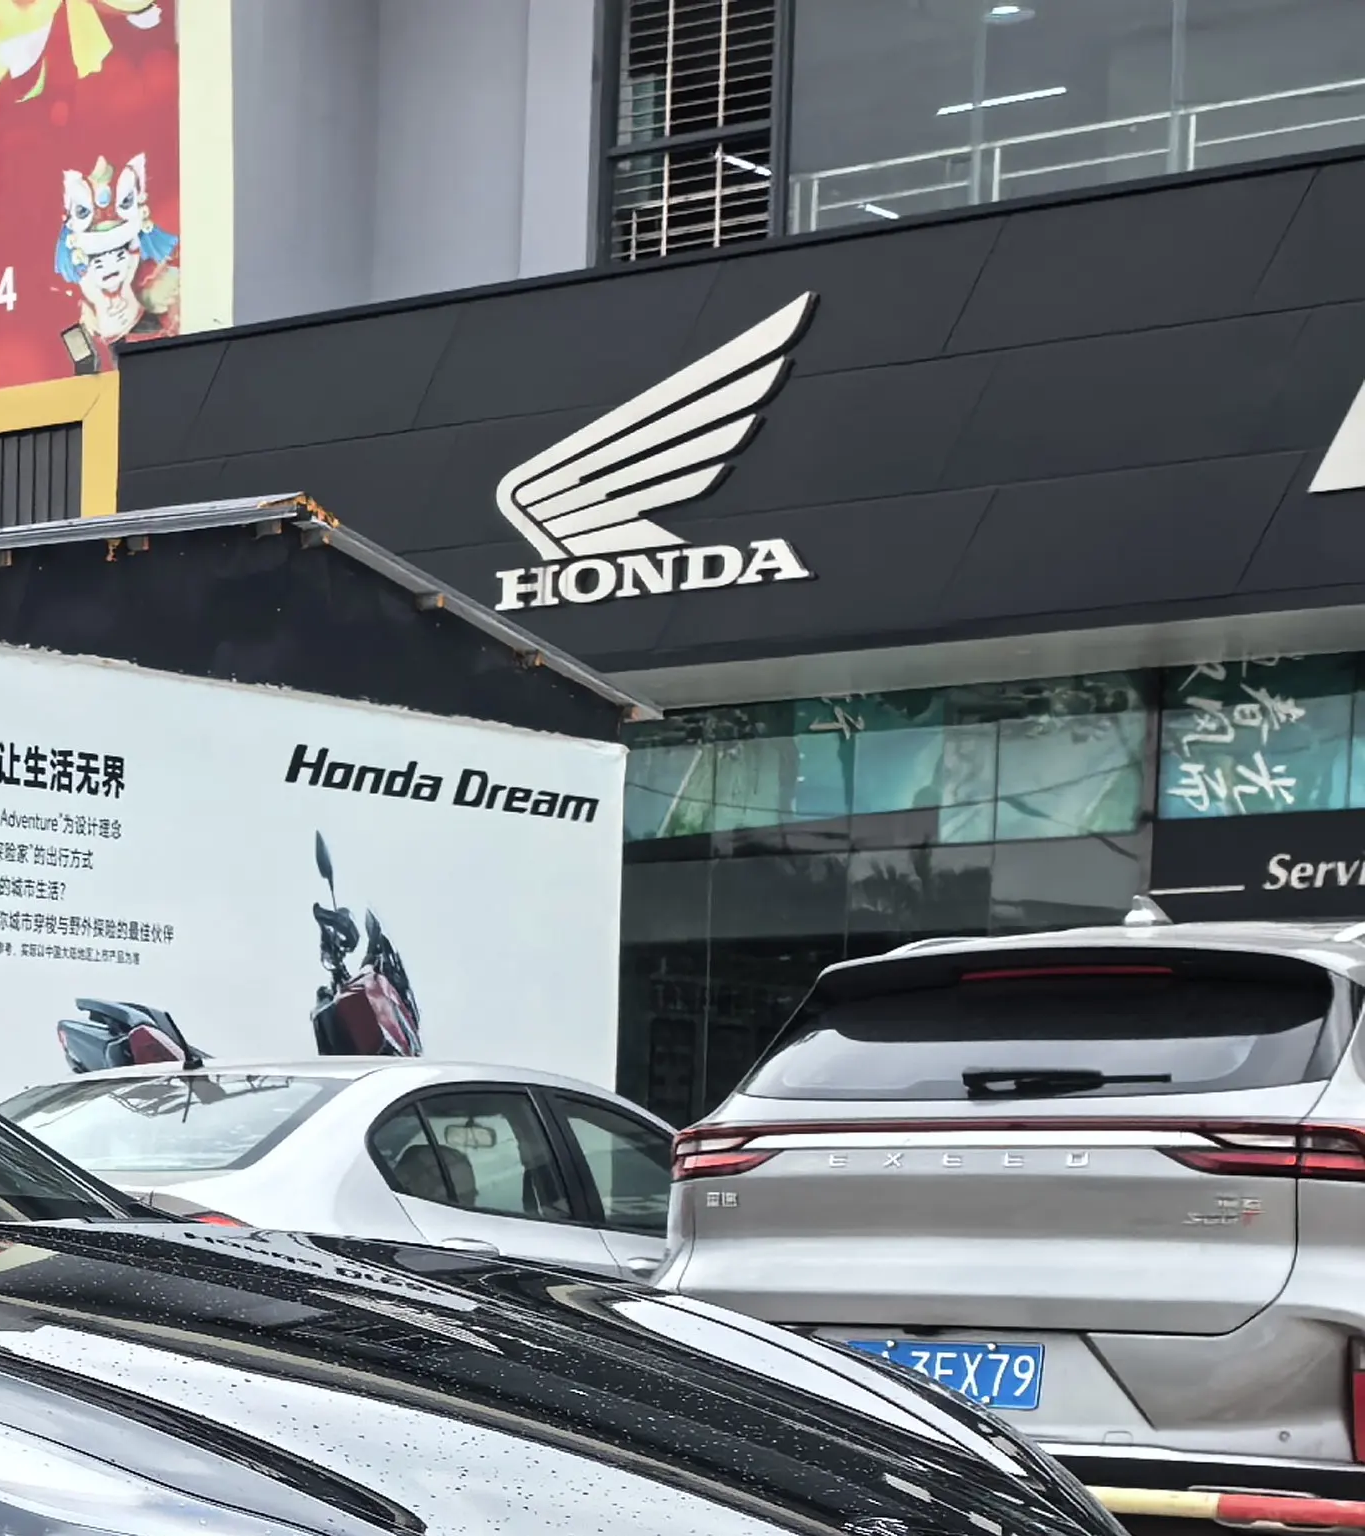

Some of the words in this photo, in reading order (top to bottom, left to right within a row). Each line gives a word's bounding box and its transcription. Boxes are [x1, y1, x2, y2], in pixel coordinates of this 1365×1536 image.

[495, 538, 817, 611] HONDA
[284, 744, 444, 802] Honda
[452, 768, 600, 824] Dream
[827, 1151, 1091, 1168] EXEED
